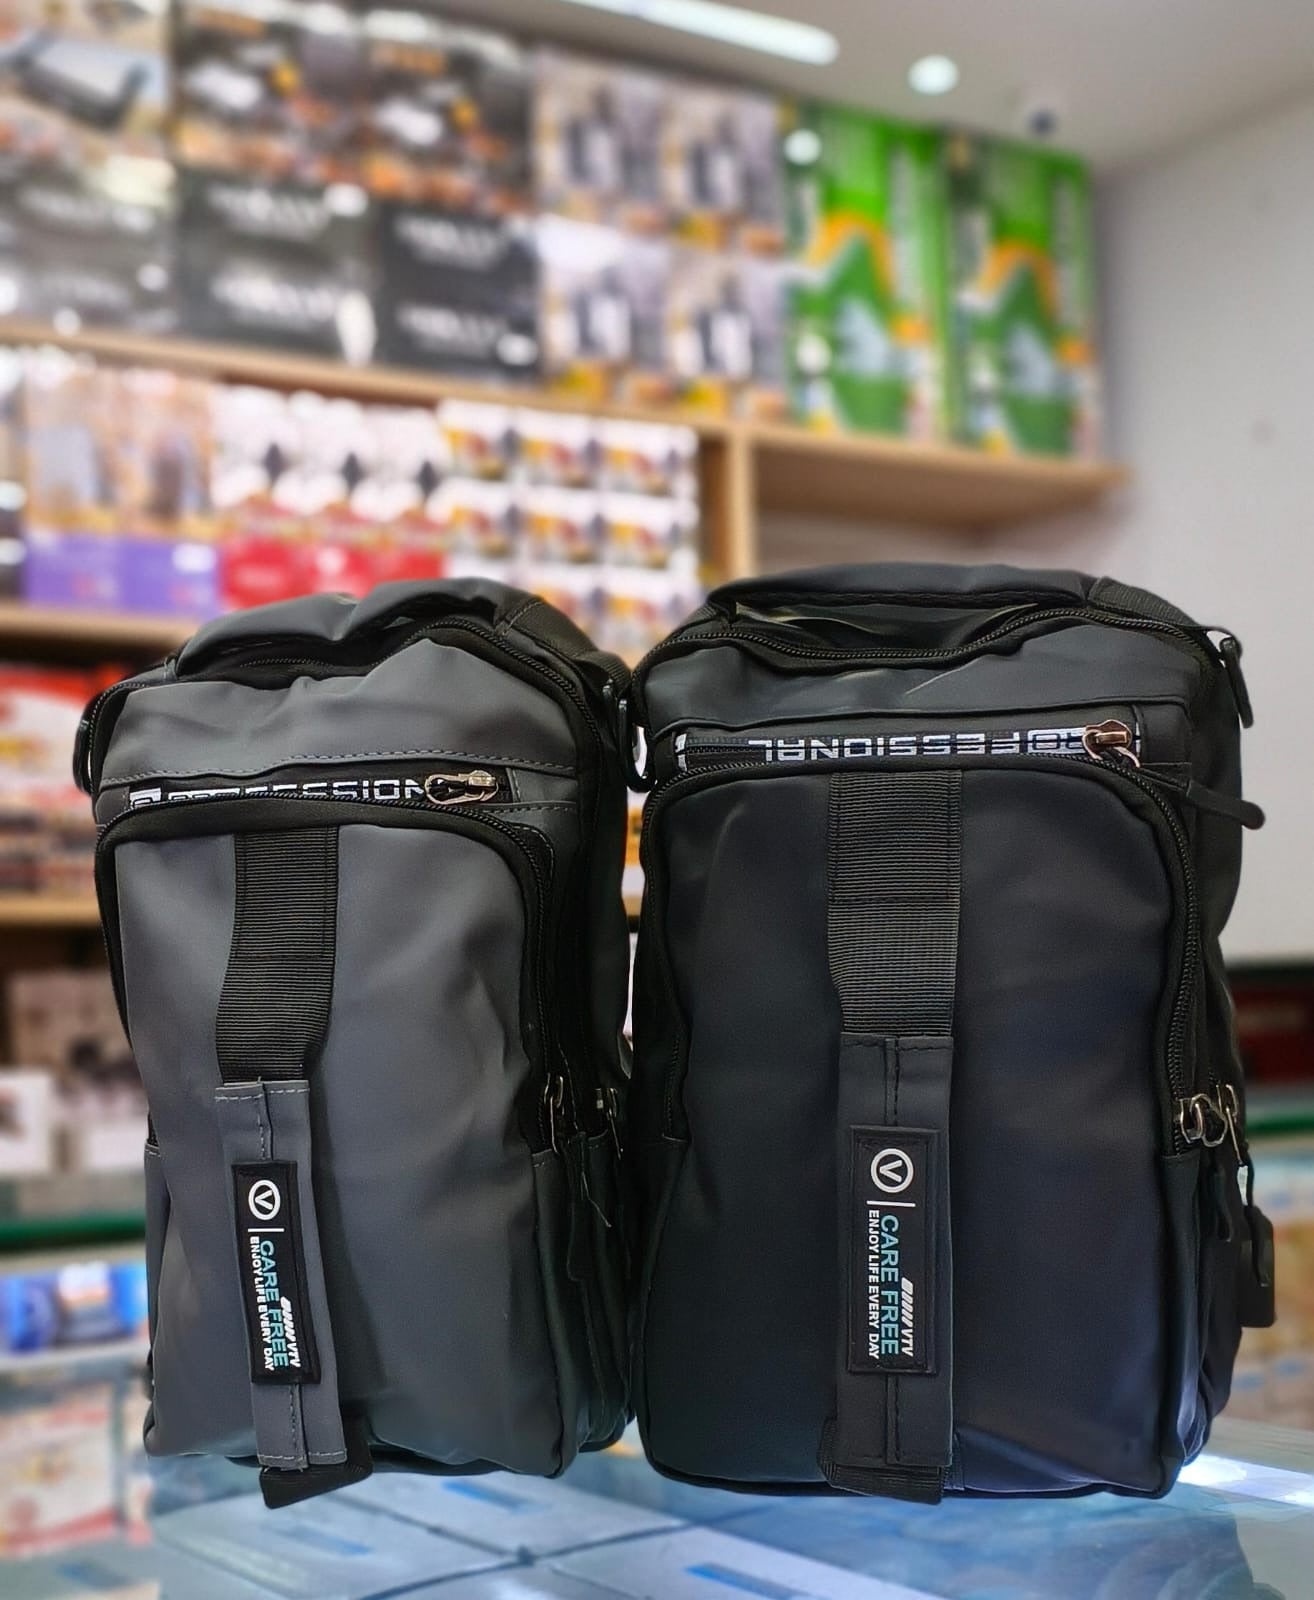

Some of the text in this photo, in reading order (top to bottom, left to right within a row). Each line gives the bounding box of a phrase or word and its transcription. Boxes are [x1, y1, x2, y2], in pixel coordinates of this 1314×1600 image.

[748, 727, 1087, 762] ROFESSIONAL
[249, 1236, 275, 1371] ENJOY LIFE EVERY DAY
[260, 1240, 289, 1367] CARE FREE
[868, 1209, 880, 1359] ENJOY LIFE EVERY DAY
[880, 1214, 899, 1354] CARE FREE
